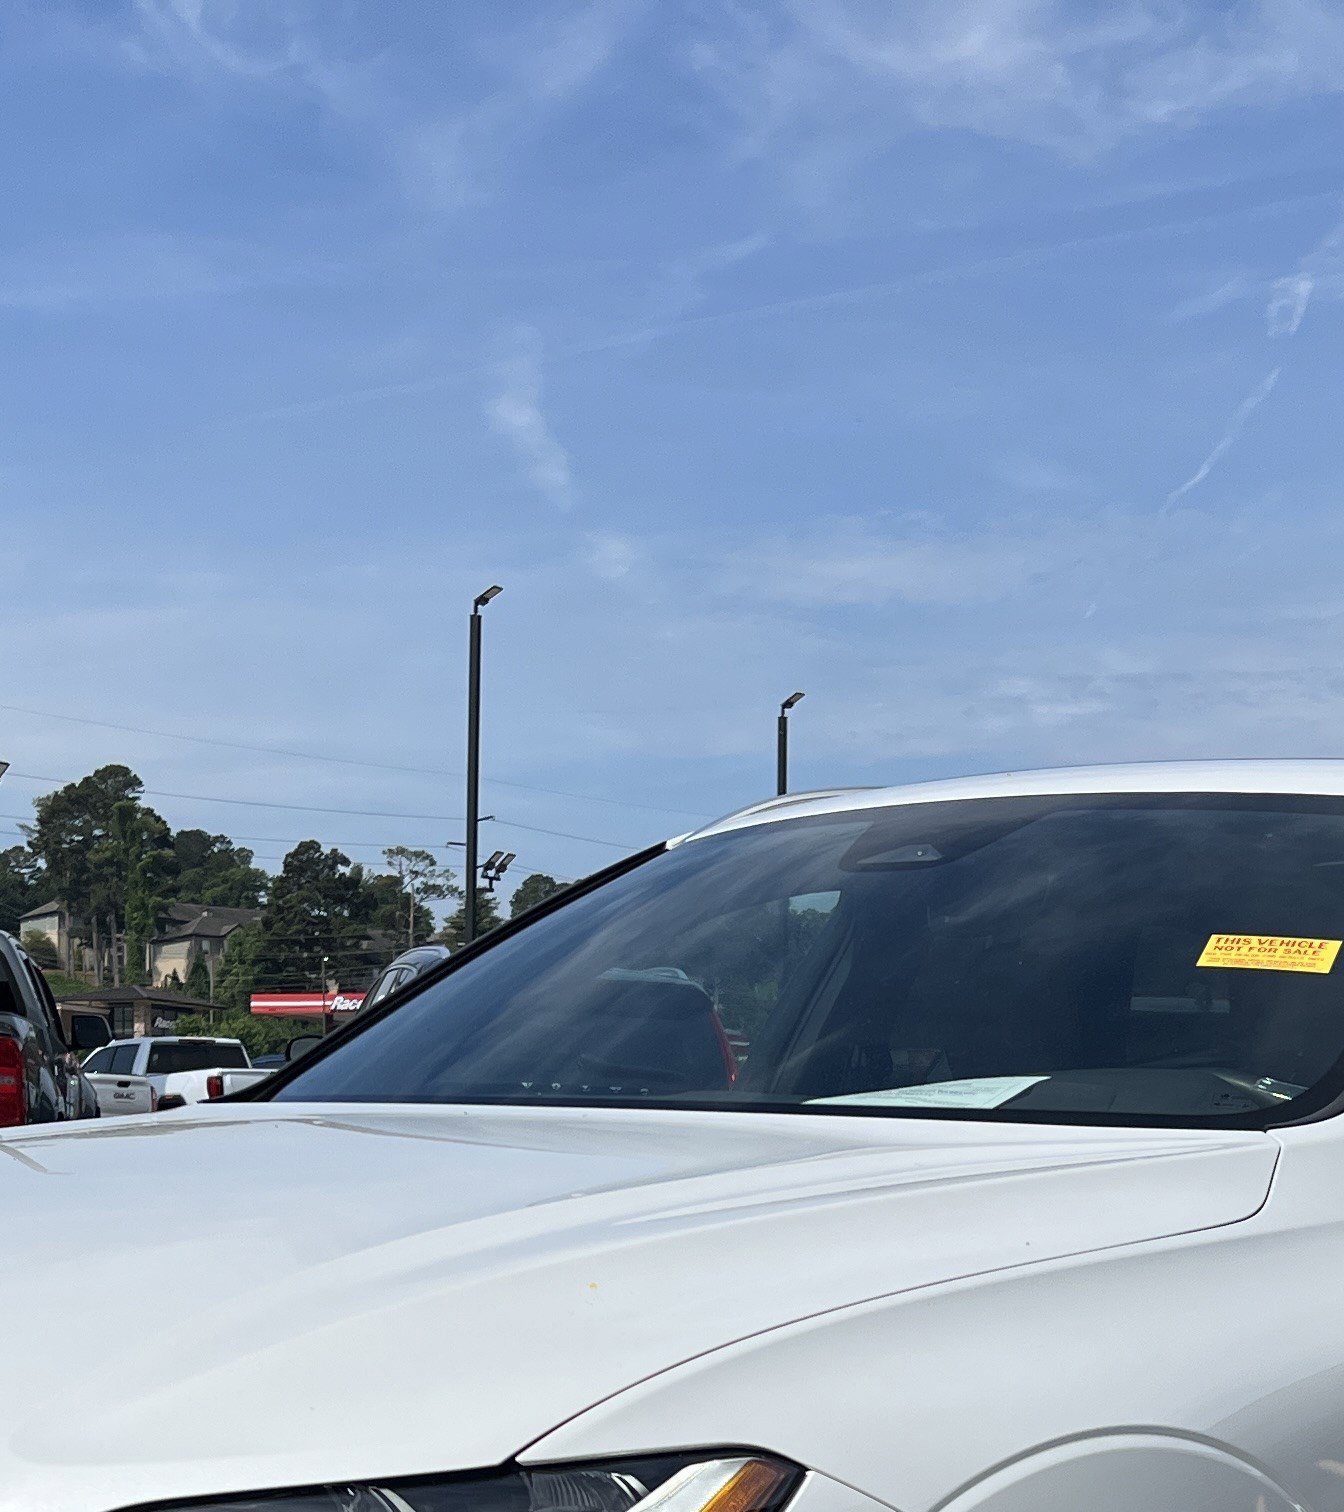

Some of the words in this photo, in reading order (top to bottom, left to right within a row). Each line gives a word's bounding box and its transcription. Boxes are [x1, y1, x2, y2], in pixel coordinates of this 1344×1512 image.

[1215, 937, 1252, 946] THIS
[1257, 938, 1330, 950] VEHICLE
[1248, 946, 1278, 954] FOR
[1282, 948, 1322, 957] SALE
